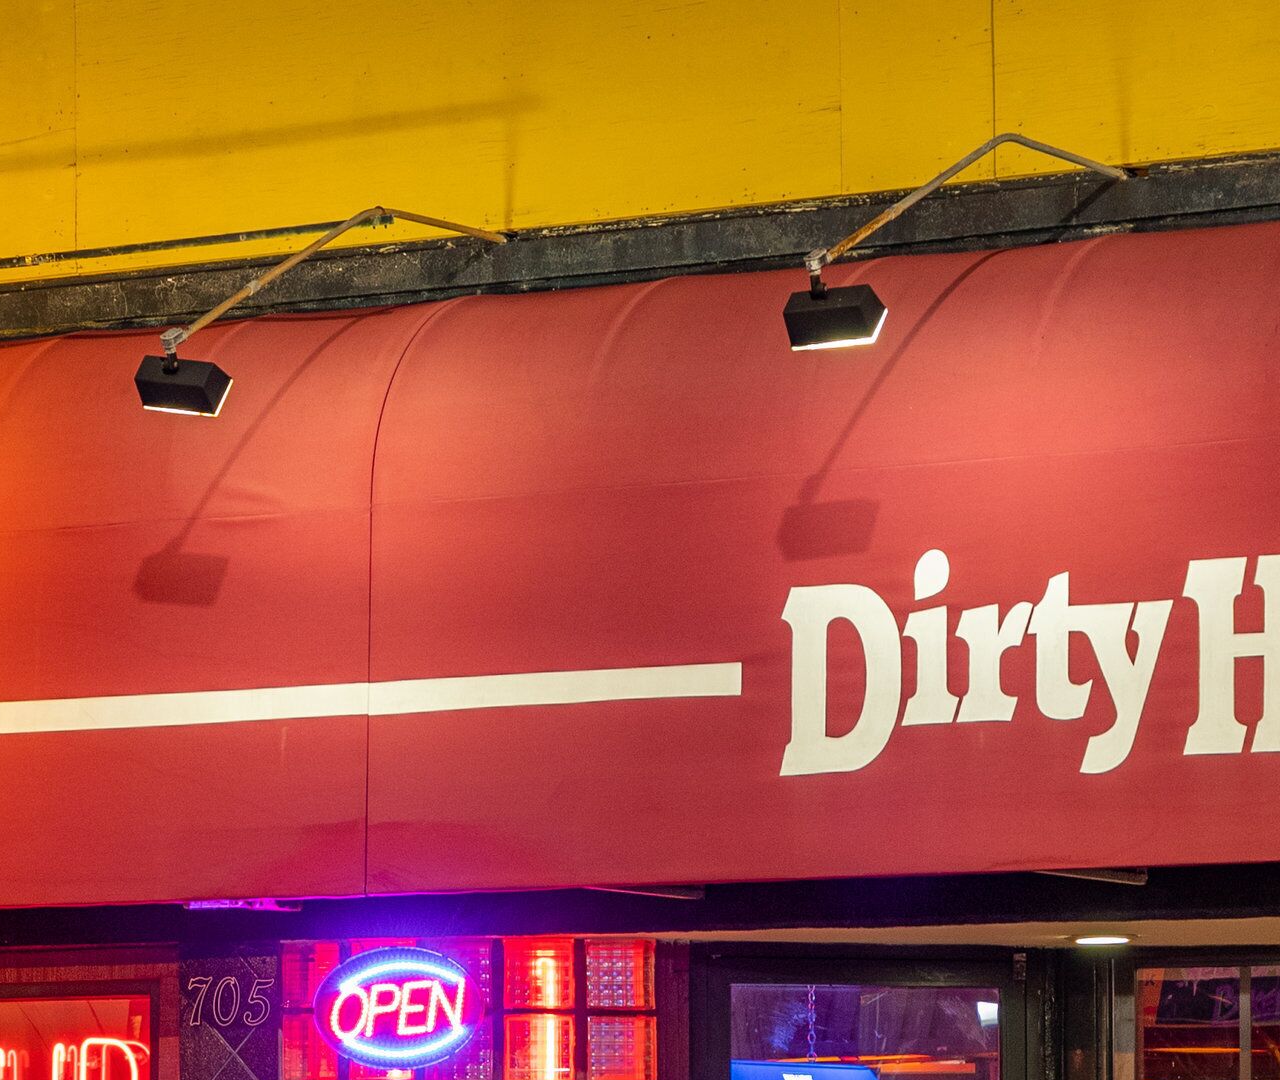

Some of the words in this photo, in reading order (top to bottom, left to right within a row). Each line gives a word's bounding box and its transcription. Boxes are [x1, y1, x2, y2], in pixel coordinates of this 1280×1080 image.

[780, 548, 1174, 776] Dirty
[187, 976, 276, 1027] 705
[330, 977, 466, 1041] OPEN
